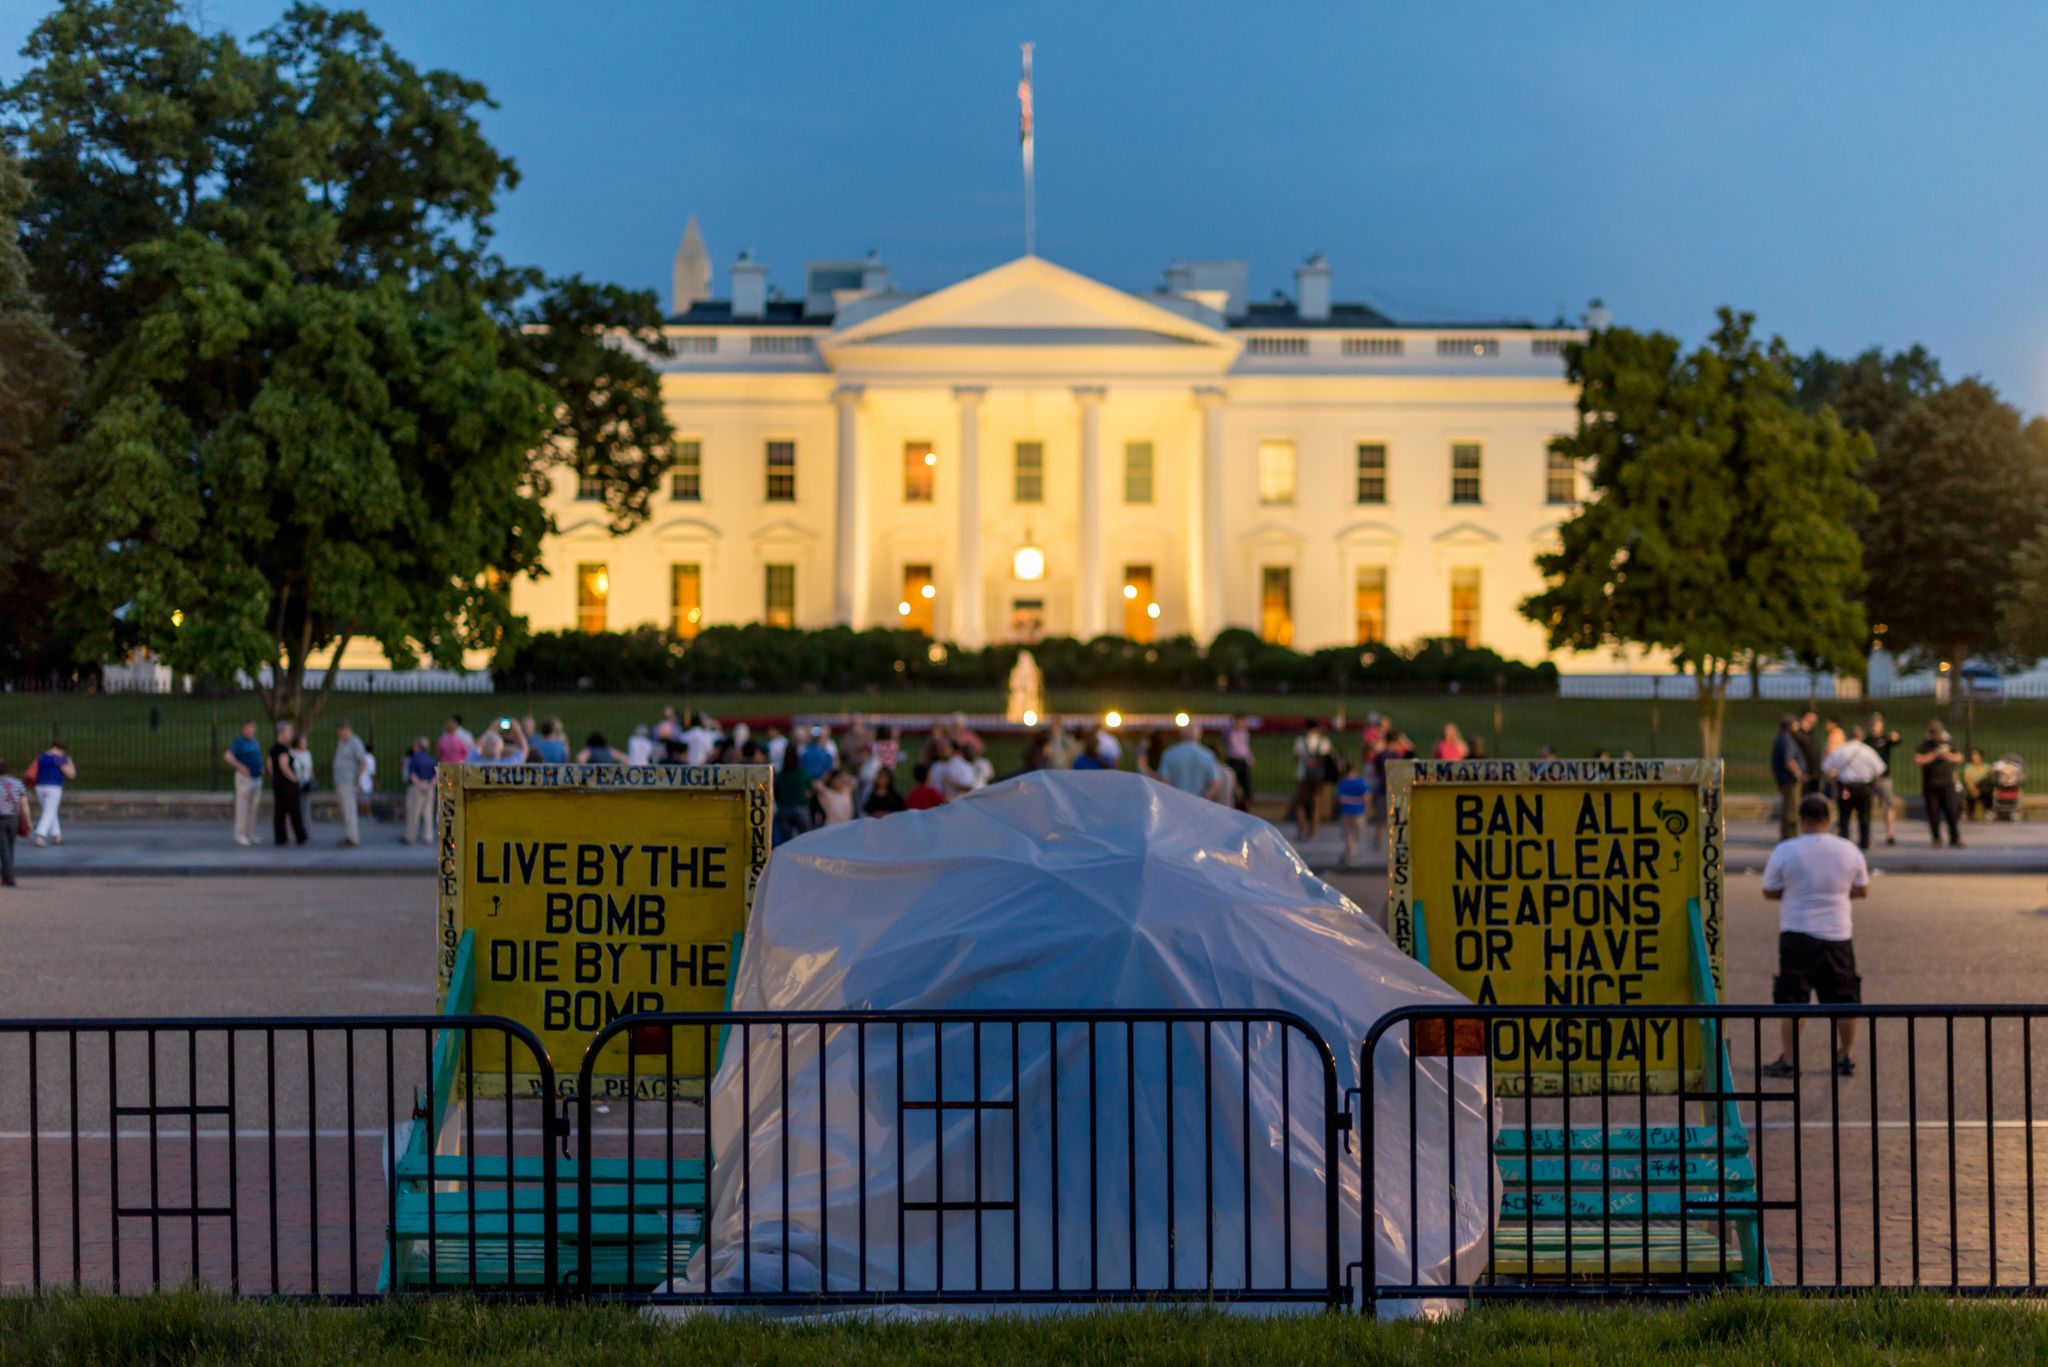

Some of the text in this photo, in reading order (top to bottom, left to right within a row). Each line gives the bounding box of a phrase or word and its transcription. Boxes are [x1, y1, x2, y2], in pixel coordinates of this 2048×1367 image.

[480, 766, 559, 786] TRUTH
[563, 767, 575, 785] &
[578, 766, 657, 786] PEACE
[1436, 762, 1516, 782] MAYER
[1529, 761, 1665, 782] MONUMENT
[1455, 792, 1658, 836] BAN ALL
[441, 799, 457, 897] SINCE
[476, 842, 727, 888] LIVE BY THE
[747, 788, 767, 910] HONES
[1394, 807, 1409, 885] LIES
[1455, 839, 1660, 881] NUCLEAR
[545, 893, 666, 936] BOMB
[1452, 883, 1661, 927] WEAPONS
[490, 940, 727, 987] DIE BY THE
[1455, 929, 1660, 971] OR HAVE
[1544, 974, 1643, 1005] NICE
[1492, 1018, 1672, 1062] OMSDAY
